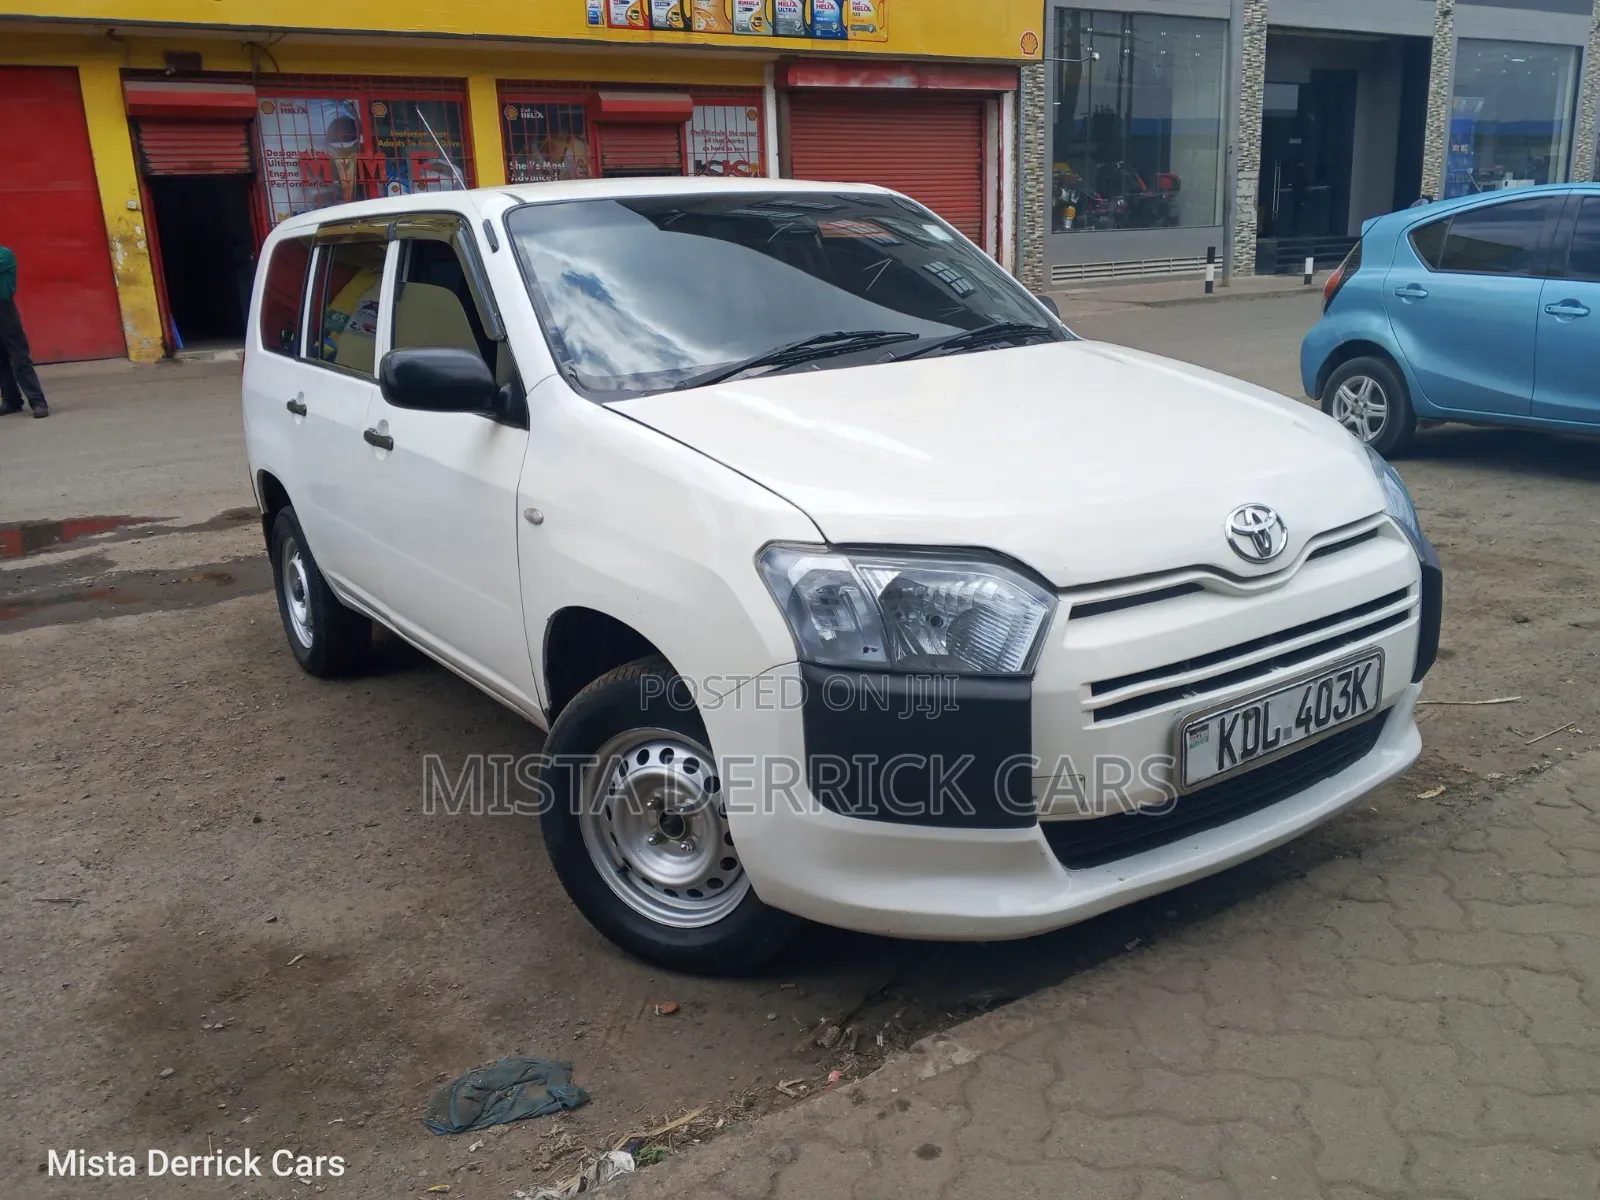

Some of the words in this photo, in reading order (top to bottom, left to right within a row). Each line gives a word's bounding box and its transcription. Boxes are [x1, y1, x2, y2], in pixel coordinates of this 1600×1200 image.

[280, 107, 308, 115] HELIX
[520, 111, 544, 119] HELIX
[542, 160, 566, 170] Most
[269, 170, 300, 180] Engine
[1217, 699, 1281, 771] KDL
[1295, 661, 1373, 735] 403K
